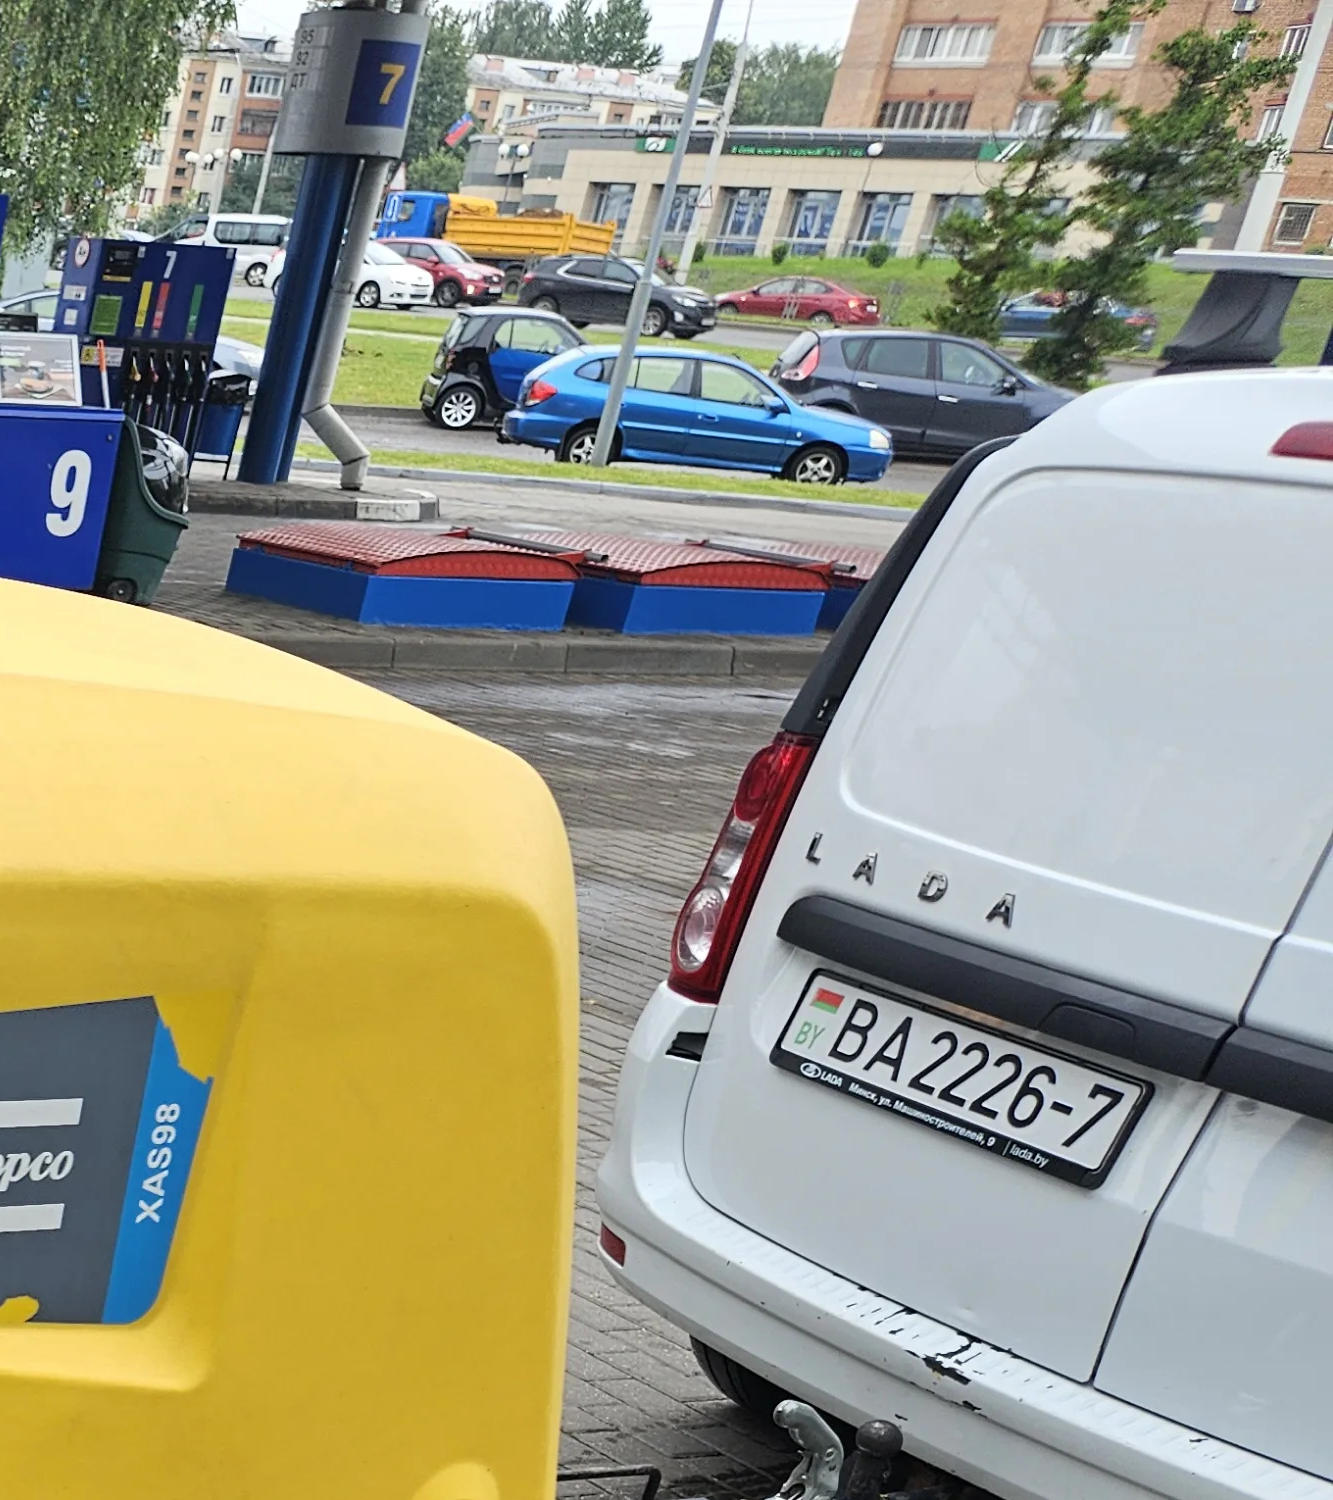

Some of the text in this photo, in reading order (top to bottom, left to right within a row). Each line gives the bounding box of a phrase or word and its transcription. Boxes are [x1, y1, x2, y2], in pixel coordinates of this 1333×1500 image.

[379, 63, 406, 105] 7
[163, 250, 177, 280] 7
[46, 449, 92, 537] 9
[805, 831, 1016, 929] LADA
[794, 1021, 825, 1050] BY
[828, 998, 1124, 1147] BA2226-7
[135, 1102, 181, 1224] XAS98
[819, 1070, 1050, 1169] LADA Минск, ул. Машиностроителей, 9 lada.by
